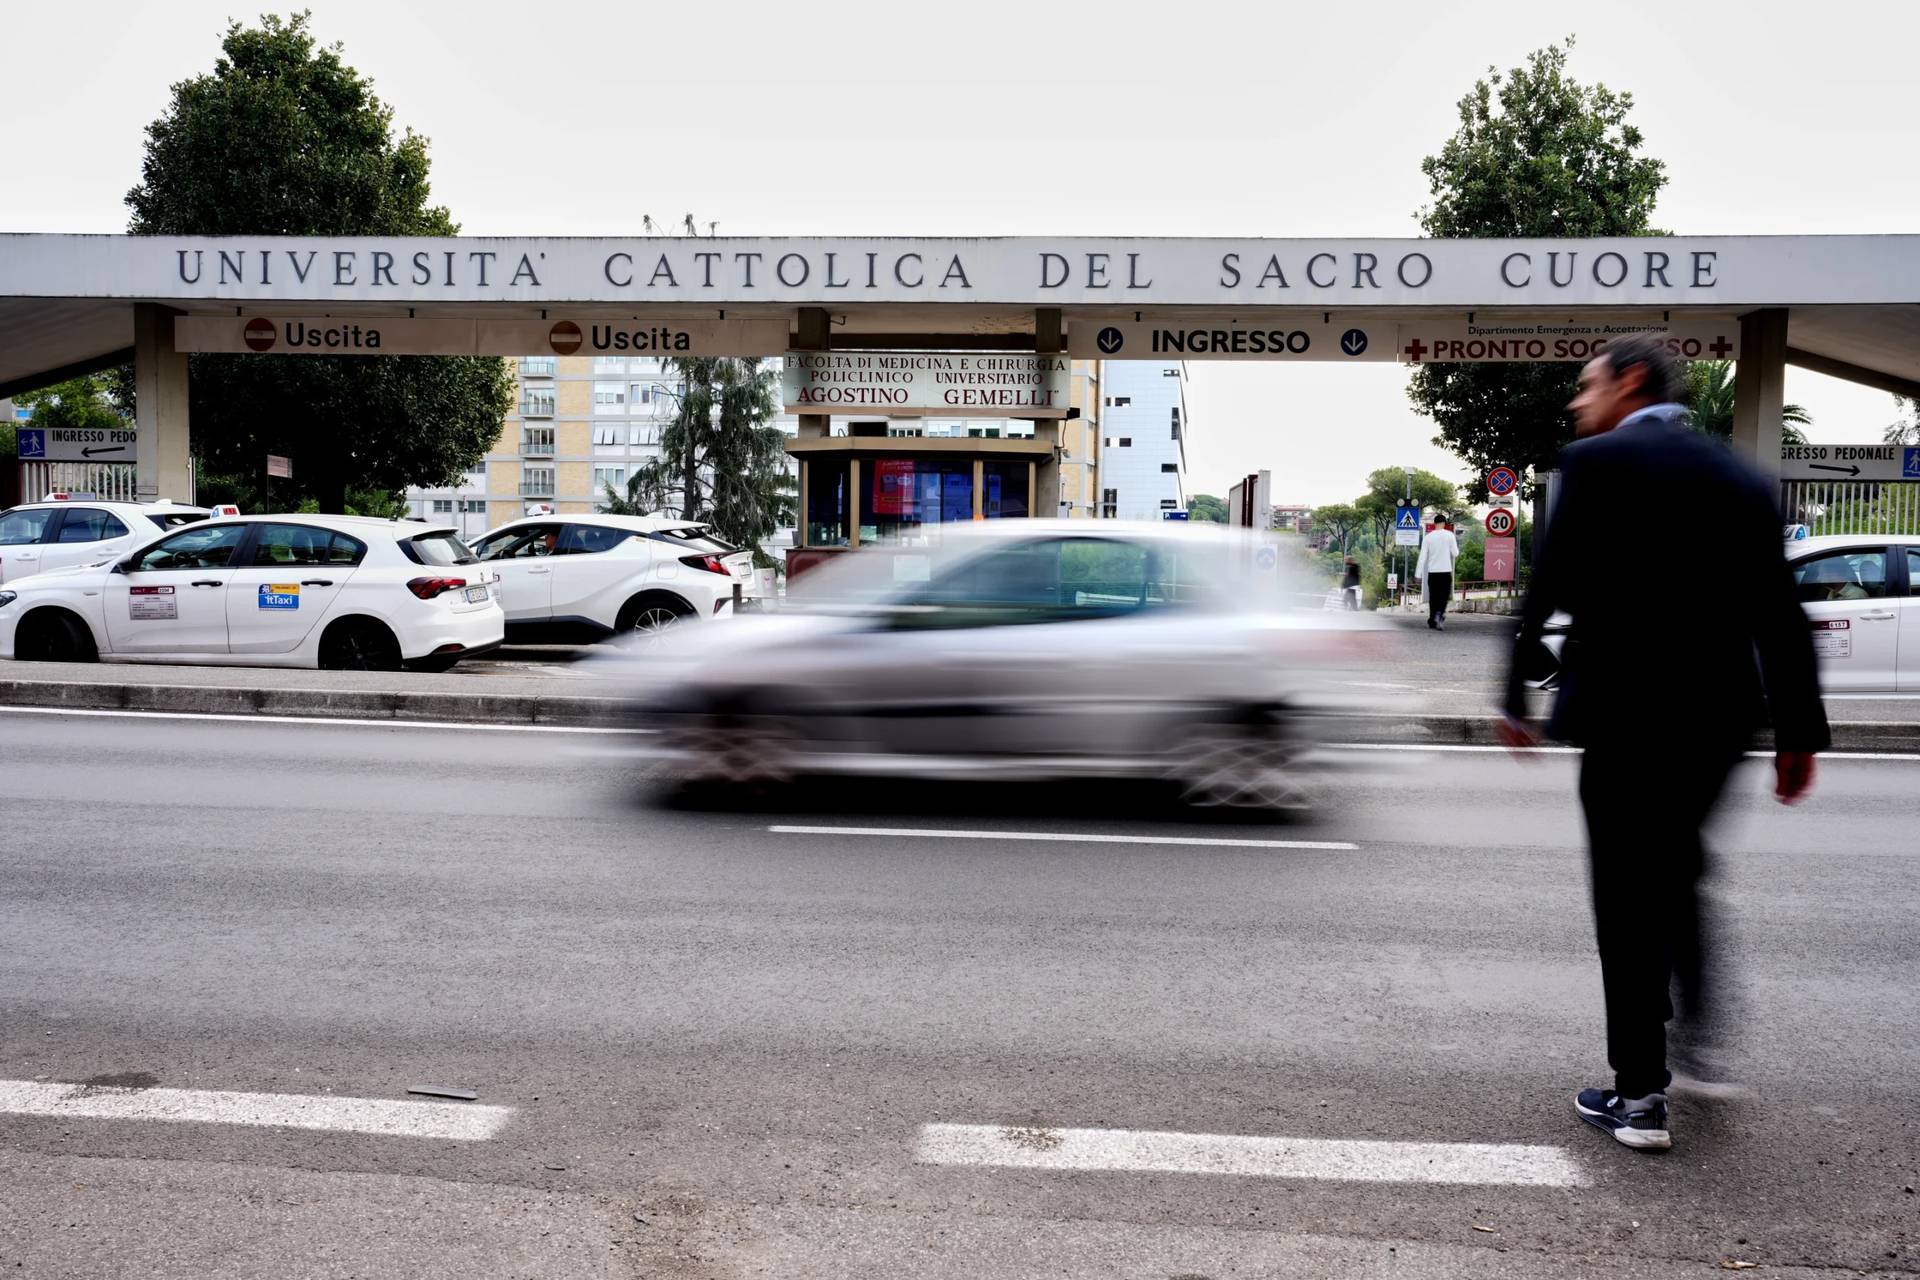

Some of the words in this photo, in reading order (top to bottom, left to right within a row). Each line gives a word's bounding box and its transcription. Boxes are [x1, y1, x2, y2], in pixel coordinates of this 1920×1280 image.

[605, 252, 972, 289] CATTOLICA
[1039, 252, 1153, 289] DEL
[1221, 252, 1433, 289] SACRO
[1501, 252, 1718, 289] CUORE
[286, 322, 381, 348] Uscita
[592, 325, 690, 350] Uscita
[1468, 325, 1534, 336] Dipartimento
[1537, 325, 1591, 336] Emergenza
[1152, 329, 1311, 354] INGRESSO
[1433, 339, 1546, 359] PRONTO
[1554, 338, 1701, 358] SOCSO
[788, 356, 852, 369] FACOLTA
[858, 357, 871, 369] DI
[878, 357, 953, 370] MEDICINA
[960, 358, 969, 370] E
[976, 358, 1066, 371] CHIRURGIA
[811, 371, 914, 384] POLICLINICO
[936, 372, 1043, 385] UNIVERSITARIO
[52, 429, 105, 443] INGRESSO
[110, 431, 137, 443] PEDO
[1834, 447, 1895, 460] PEDONALE
[1491, 516, 1509, 530] 30
